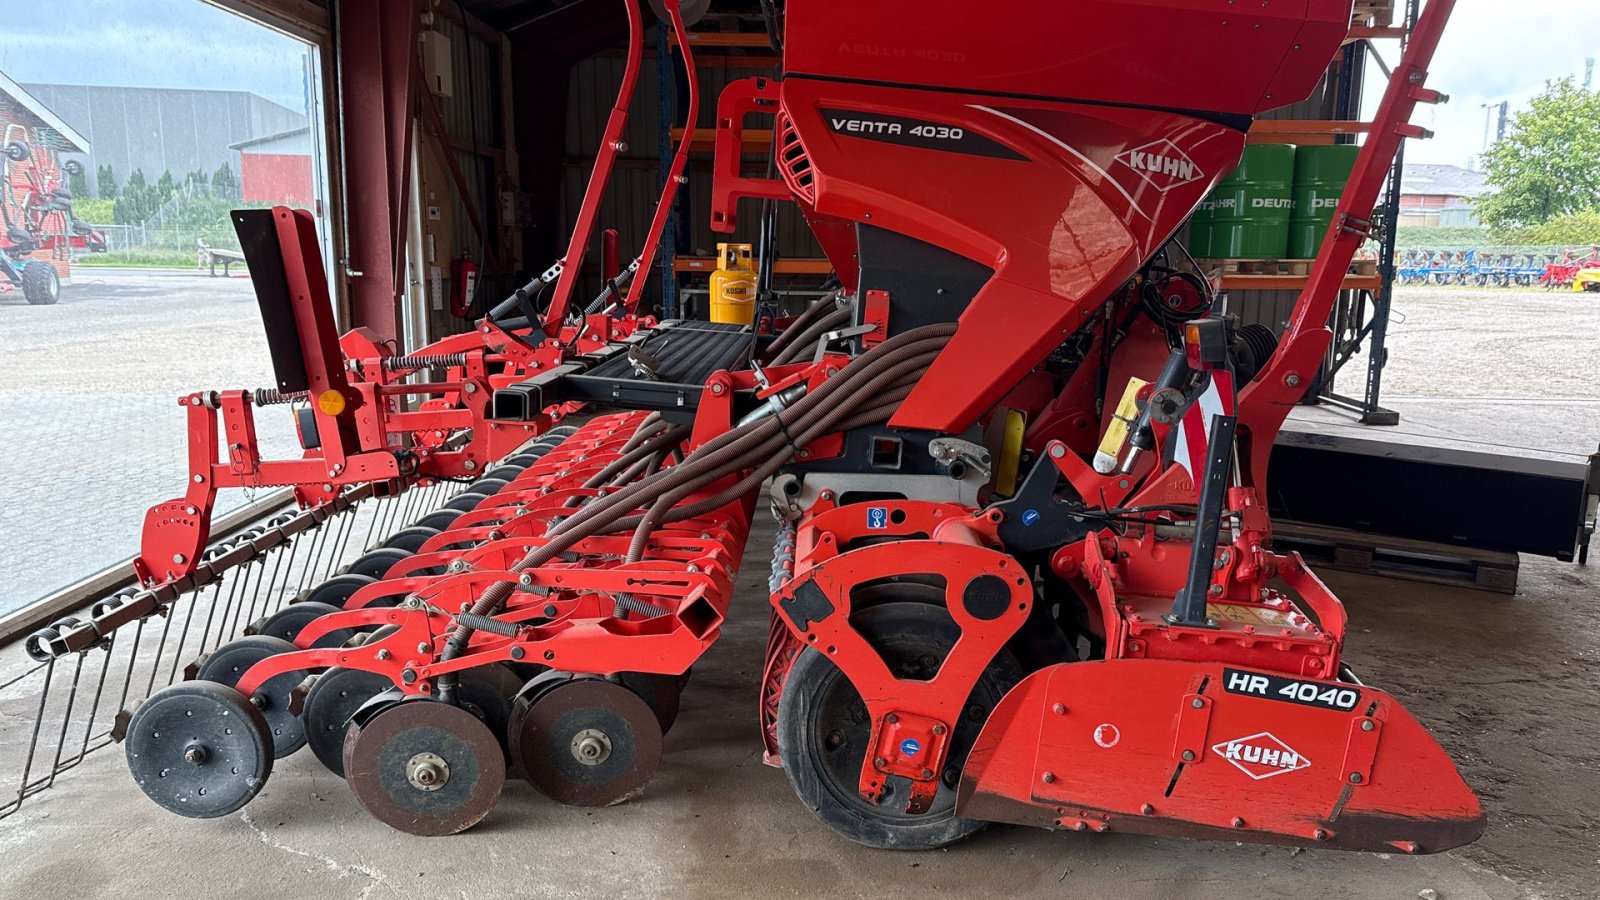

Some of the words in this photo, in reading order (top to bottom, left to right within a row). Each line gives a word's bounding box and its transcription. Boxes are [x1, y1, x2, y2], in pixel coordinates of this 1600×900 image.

[831, 118, 902, 135] VENTA
[908, 125, 964, 140] 4030
[1130, 150, 1194, 181] KUHN
[1227, 672, 1269, 695] HR
[1278, 682, 1357, 708] 4040
[1225, 741, 1299, 769] KUHN
